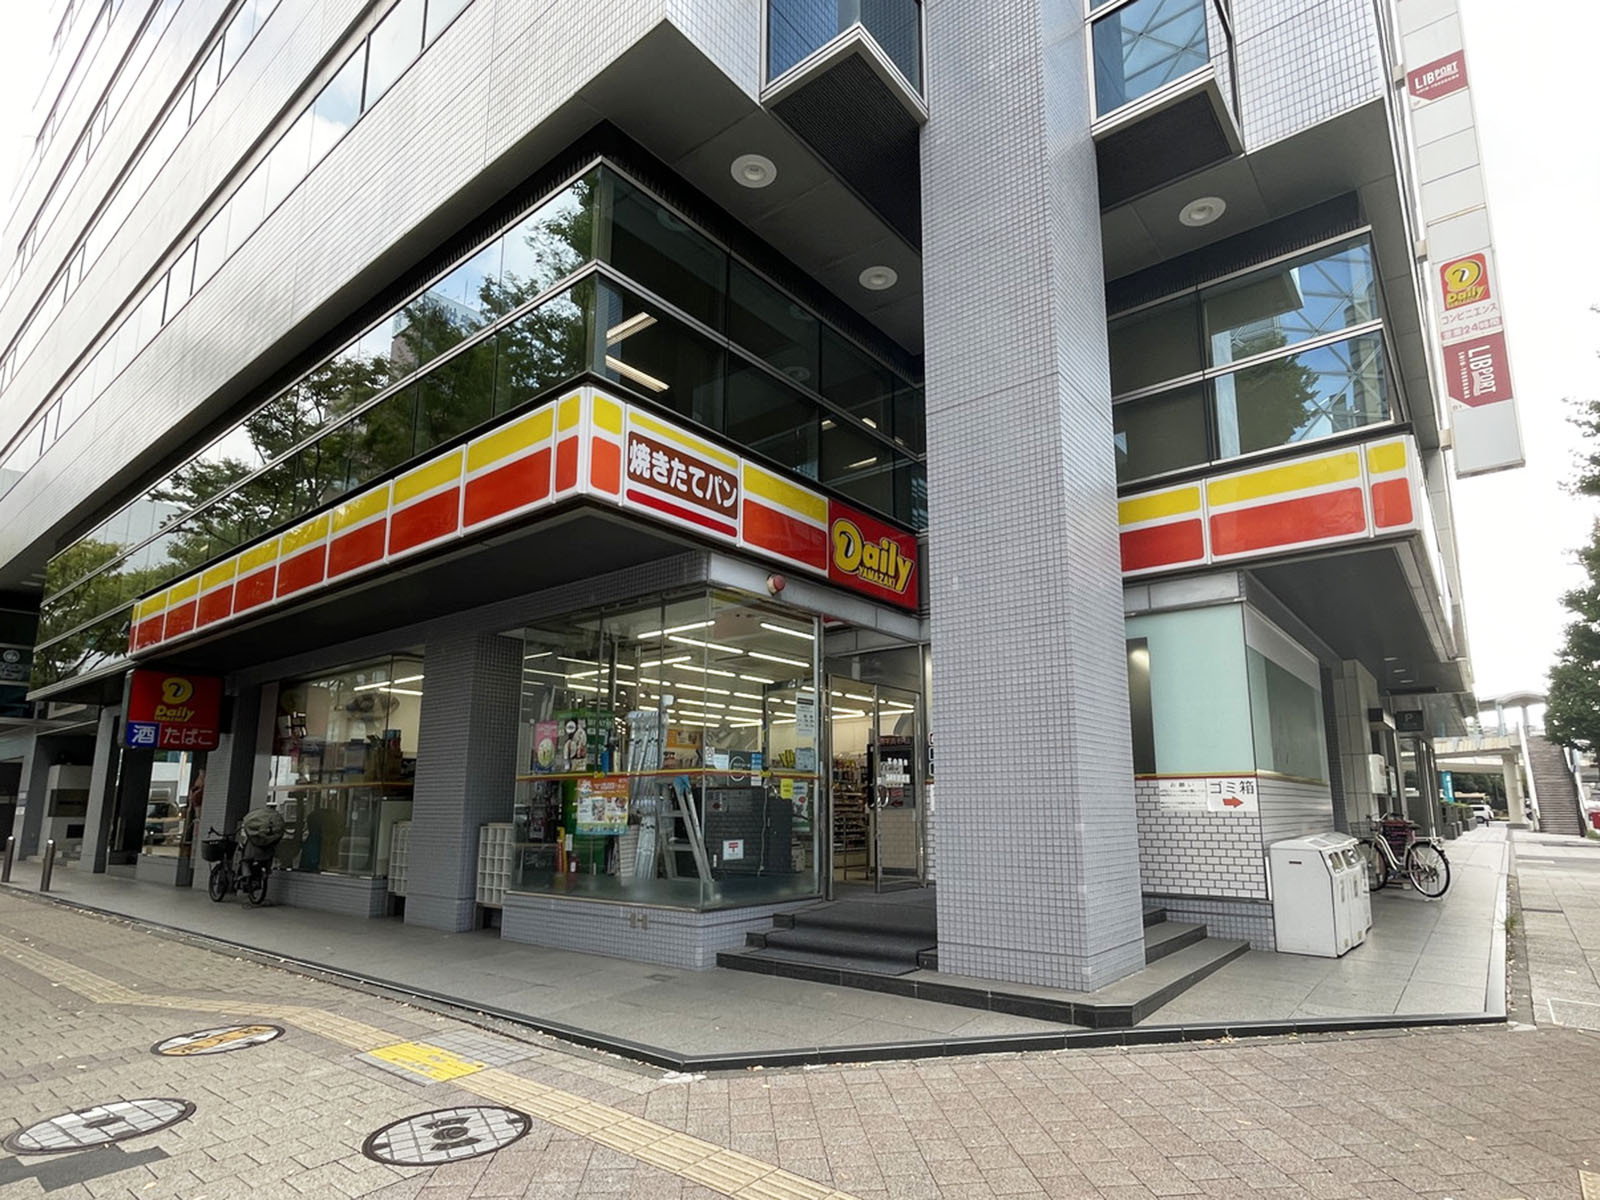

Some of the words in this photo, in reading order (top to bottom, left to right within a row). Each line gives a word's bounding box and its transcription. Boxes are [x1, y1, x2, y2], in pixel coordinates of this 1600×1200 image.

[1414, 61, 1459, 89] LIBPORT
[1447, 285, 1486, 303] Daily
[1441, 303, 1498, 325] コンビニエンス
[1468, 345, 1496, 394] LIBPORT
[629, 439, 737, 508] 焼きたてパン
[833, 519, 912, 592] Daily
[858, 566, 896, 588] YAMAZAKI
[154, 705, 195, 722] Daily
[131, 724, 156, 744] 酒
[163, 726, 213, 745] たばこ
[1210, 780, 1254, 795] ゴミ箱
